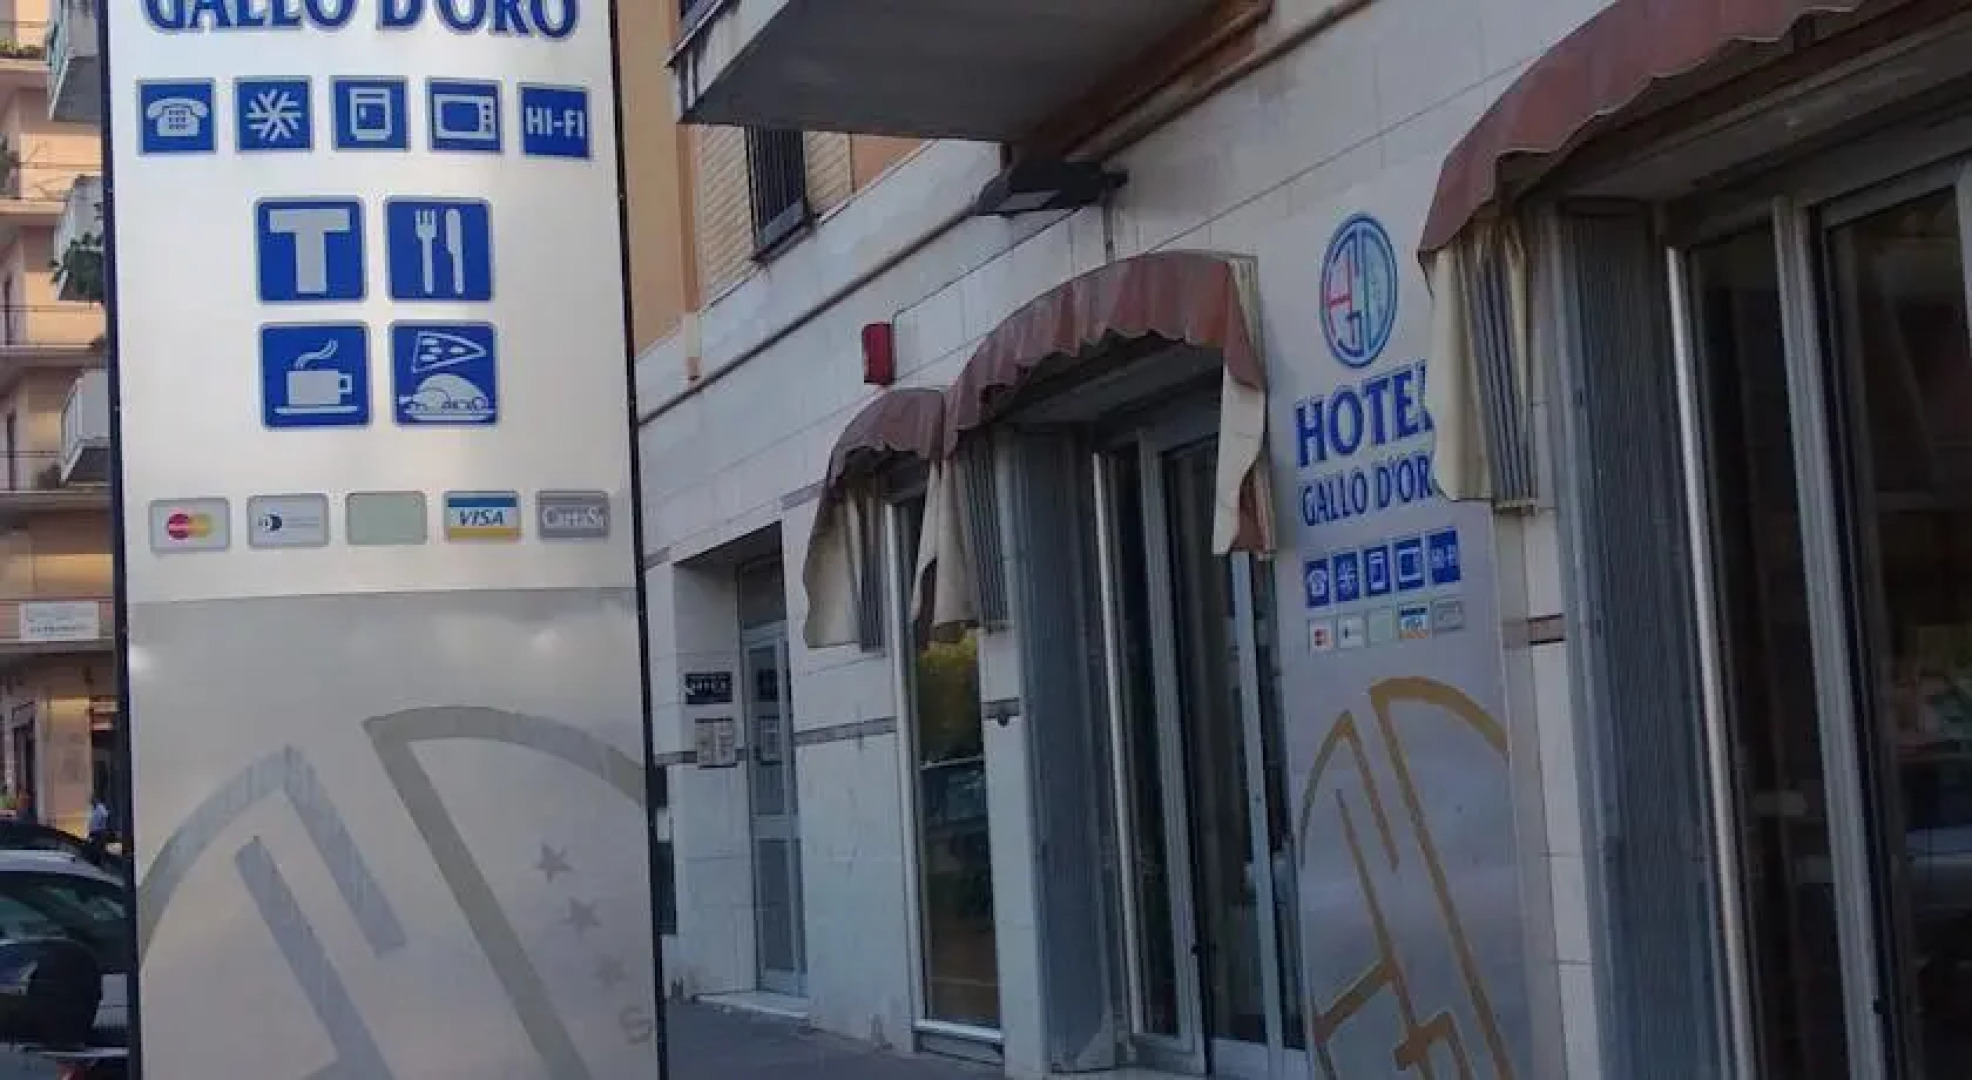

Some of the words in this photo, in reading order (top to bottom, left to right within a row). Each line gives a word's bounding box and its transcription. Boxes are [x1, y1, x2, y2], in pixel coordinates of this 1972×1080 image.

[378, 0, 579, 40] DORO
[525, 106, 585, 138] HI-FI
[1301, 468, 1368, 527] GALLO
[1373, 453, 1435, 509] D'OR
[458, 509, 504, 527] VISA
